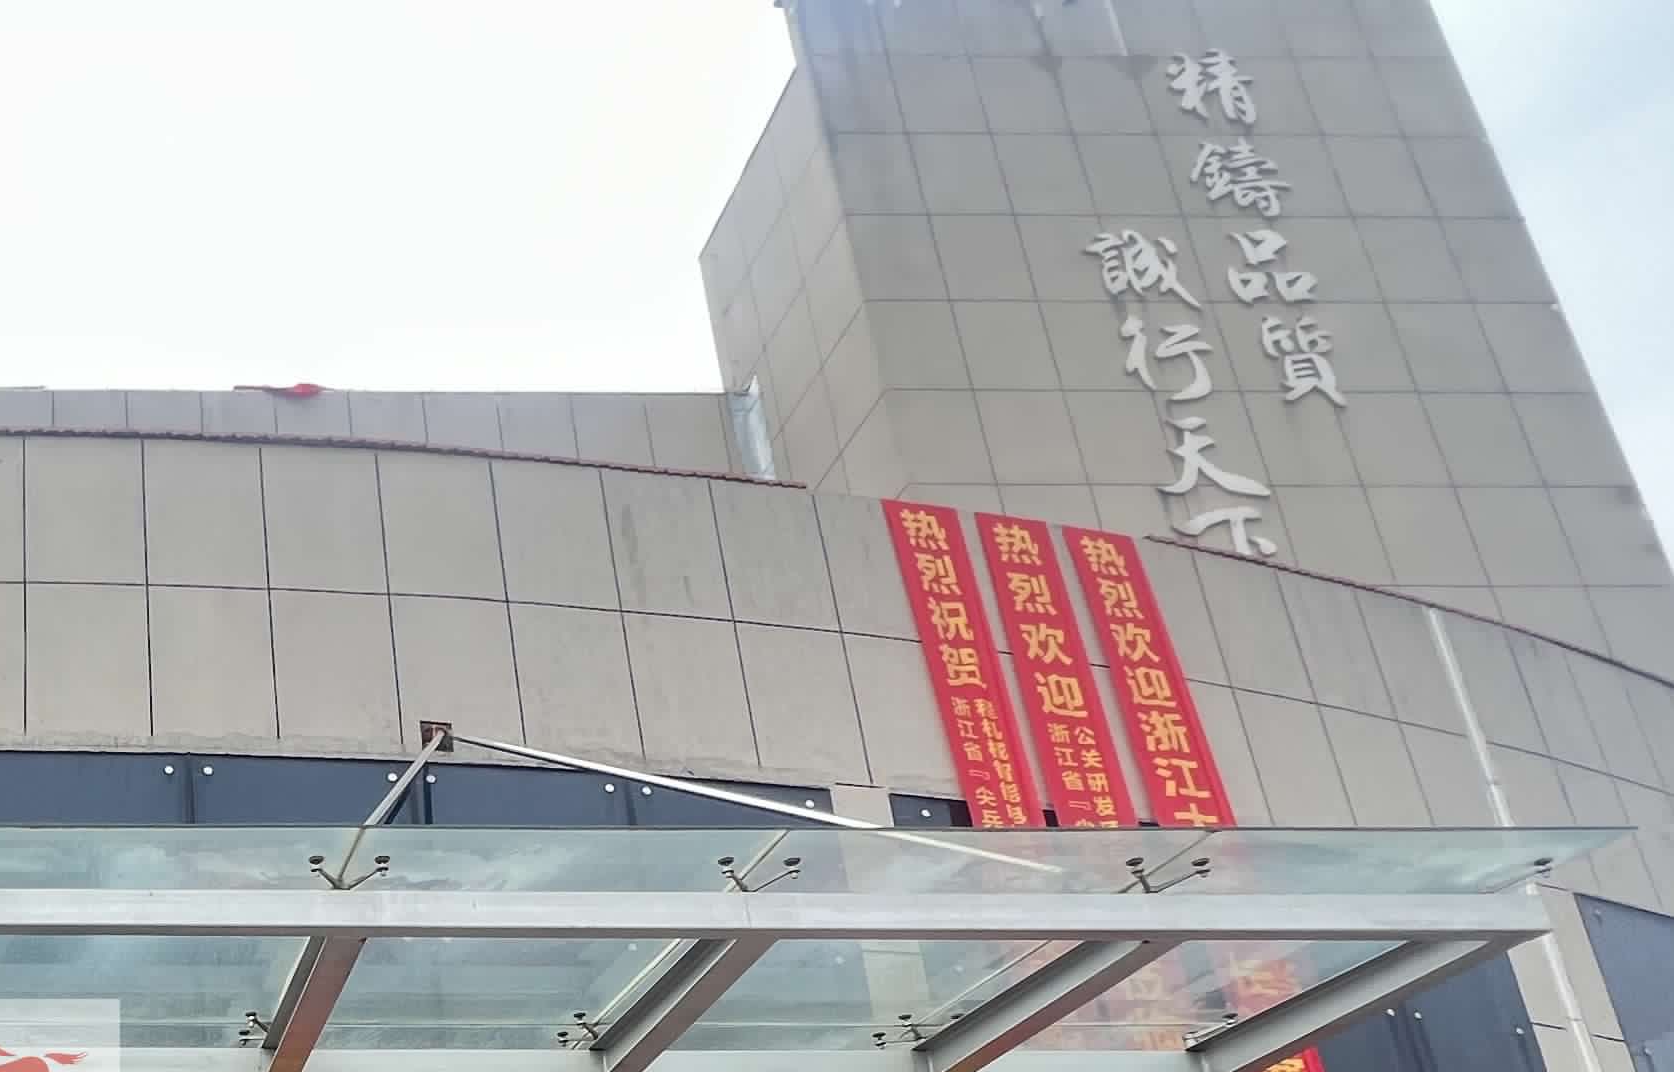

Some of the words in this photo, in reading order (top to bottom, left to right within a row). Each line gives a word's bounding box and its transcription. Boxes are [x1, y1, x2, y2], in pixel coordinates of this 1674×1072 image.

[1167, 49, 1347, 407] 精鑄品質
[1083, 229, 1277, 556] 誠行天下
[900, 509, 987, 689] 热烈祝贺
[993, 522, 1089, 718] 热烈欢迎
